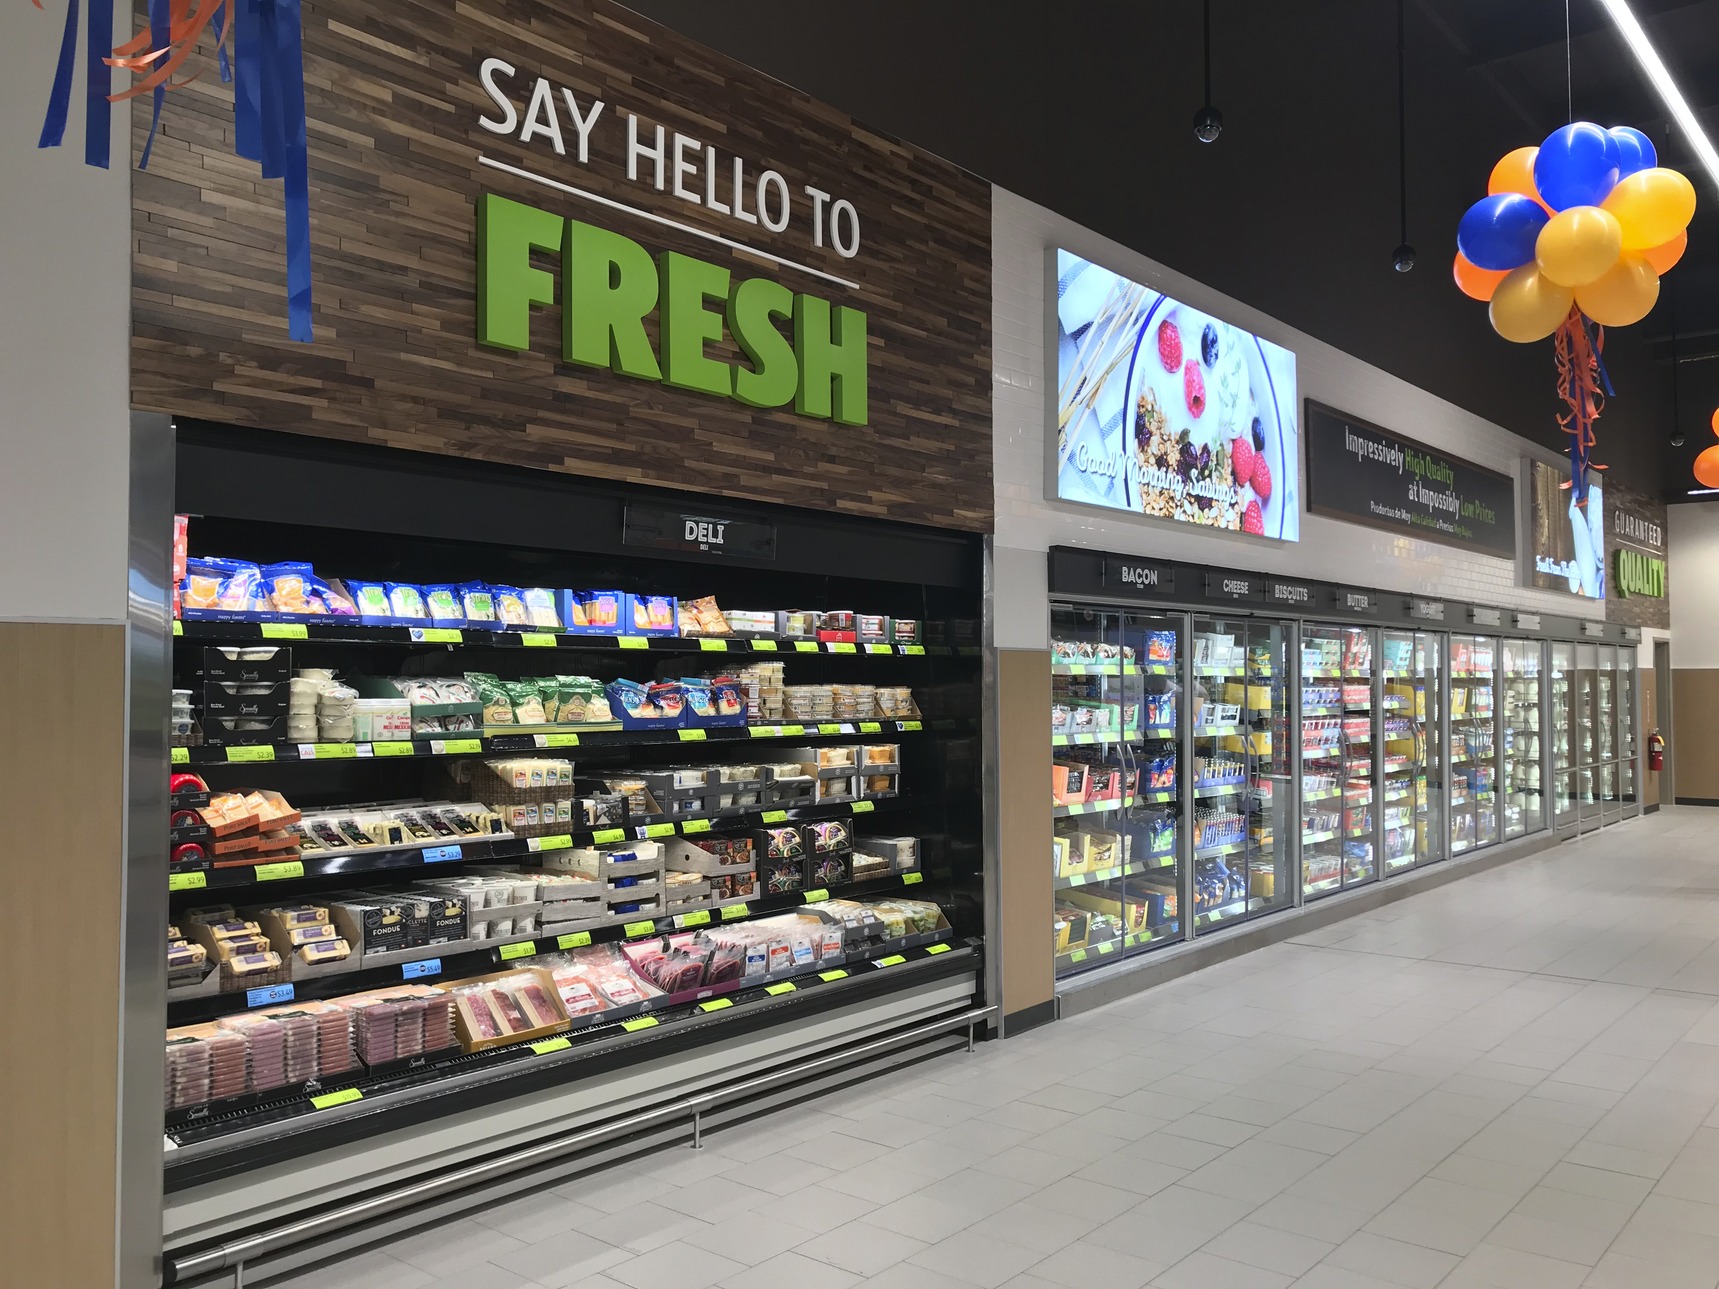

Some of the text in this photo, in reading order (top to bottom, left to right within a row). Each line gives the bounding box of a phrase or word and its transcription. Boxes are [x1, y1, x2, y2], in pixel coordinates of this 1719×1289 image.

[477, 57, 860, 258] SAY HELLO TO
[477, 192, 868, 427] FRESH
[1076, 441, 1117, 478] Good
[1345, 425, 1455, 491] Impressively High Quality
[1408, 481, 1496, 525] at Impossibly Low Prices
[685, 520, 725, 544] DELI
[1614, 510, 1662, 547] GUARANTEED
[700, 543, 709, 551] DELI
[1122, 566, 1158, 585] BACON
[1615, 548, 1665, 598] QUALITY
[1223, 579, 1249, 594] CHEESE
[1275, 584, 1308, 601] BISCUITS
[1347, 593, 1369, 608] BUTTER
[372, 924, 401, 936] FONDUE
[436, 917, 461, 927] FONDUE
